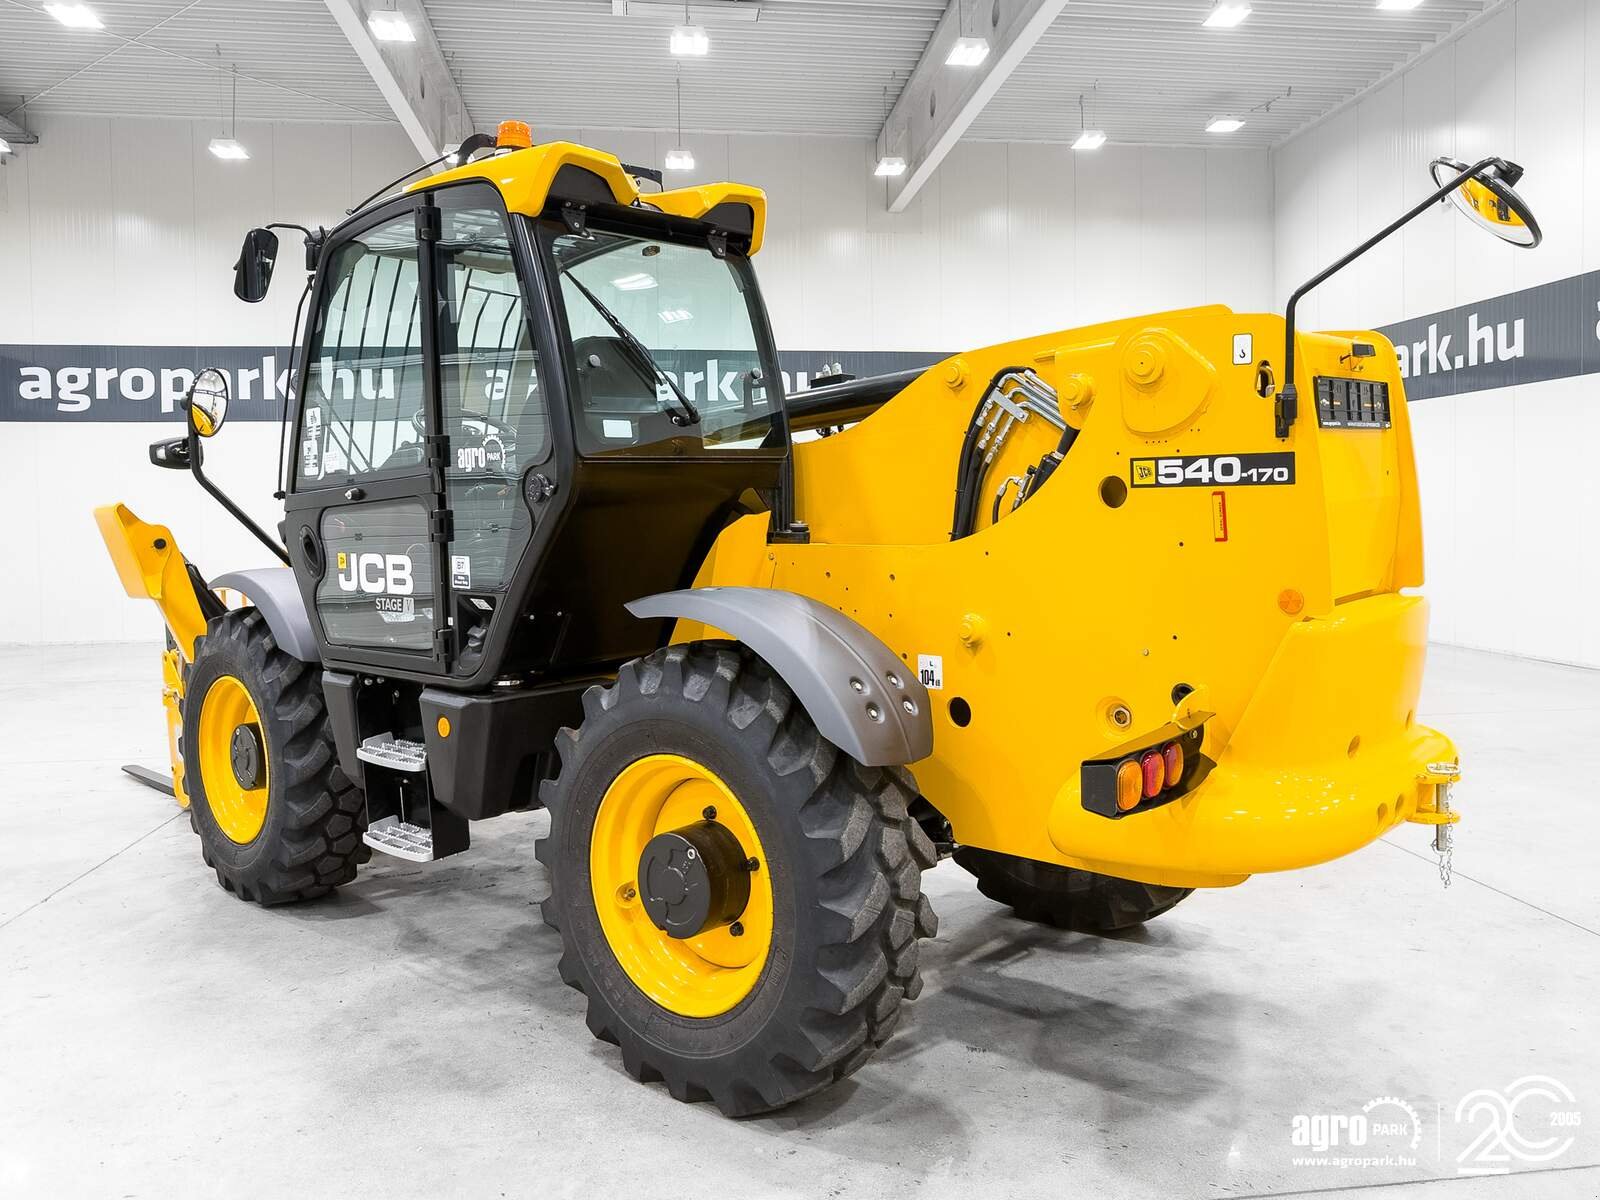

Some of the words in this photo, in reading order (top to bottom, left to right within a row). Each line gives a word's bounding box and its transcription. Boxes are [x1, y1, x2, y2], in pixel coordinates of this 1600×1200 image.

[19, 355, 394, 413] agroprkhu
[457, 447, 486, 472] agro
[486, 452, 501, 461] PARK
[1157, 456, 1289, 485] 540-170
[337, 553, 414, 595] JCB
[375, 597, 403, 612] STAGE
[920, 669, 935, 686] 104
